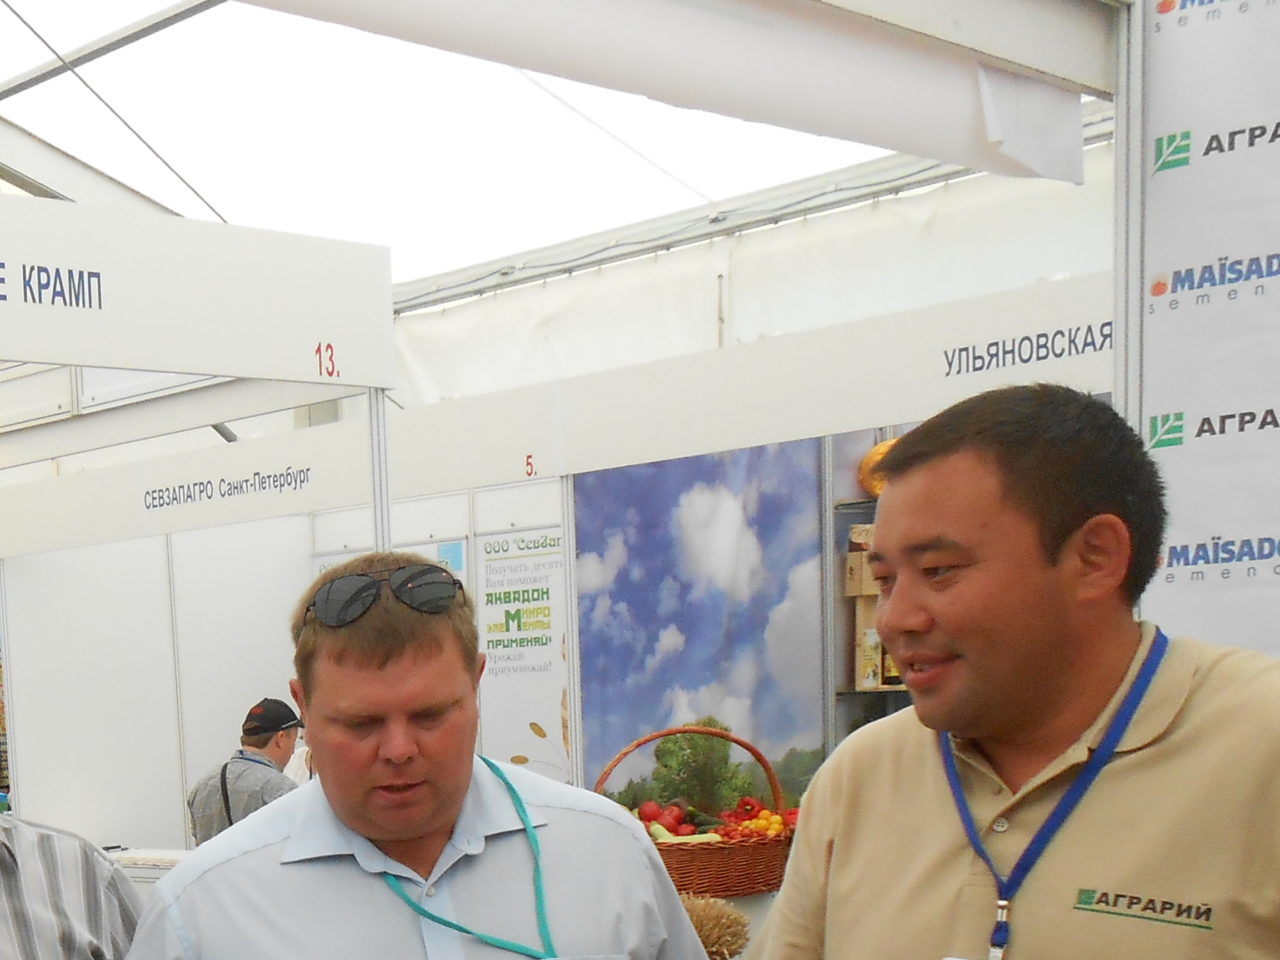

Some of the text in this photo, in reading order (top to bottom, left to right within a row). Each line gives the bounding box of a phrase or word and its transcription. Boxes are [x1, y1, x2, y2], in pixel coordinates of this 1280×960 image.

[22, 263, 103, 310] КРАМП
[315, 342, 340, 378] 13.
[944, 321, 1113, 377] УЛЬЯНОВСКАЯ
[1195, 409, 1280, 438] АГРА
[525, 454, 538, 478] 5.
[144, 466, 311, 510] СЕВЗАПАГРО Санкт-Петербург
[485, 588, 550, 606] АКВАДОН
[1095, 892, 1213, 922] АГРАРИЙ
